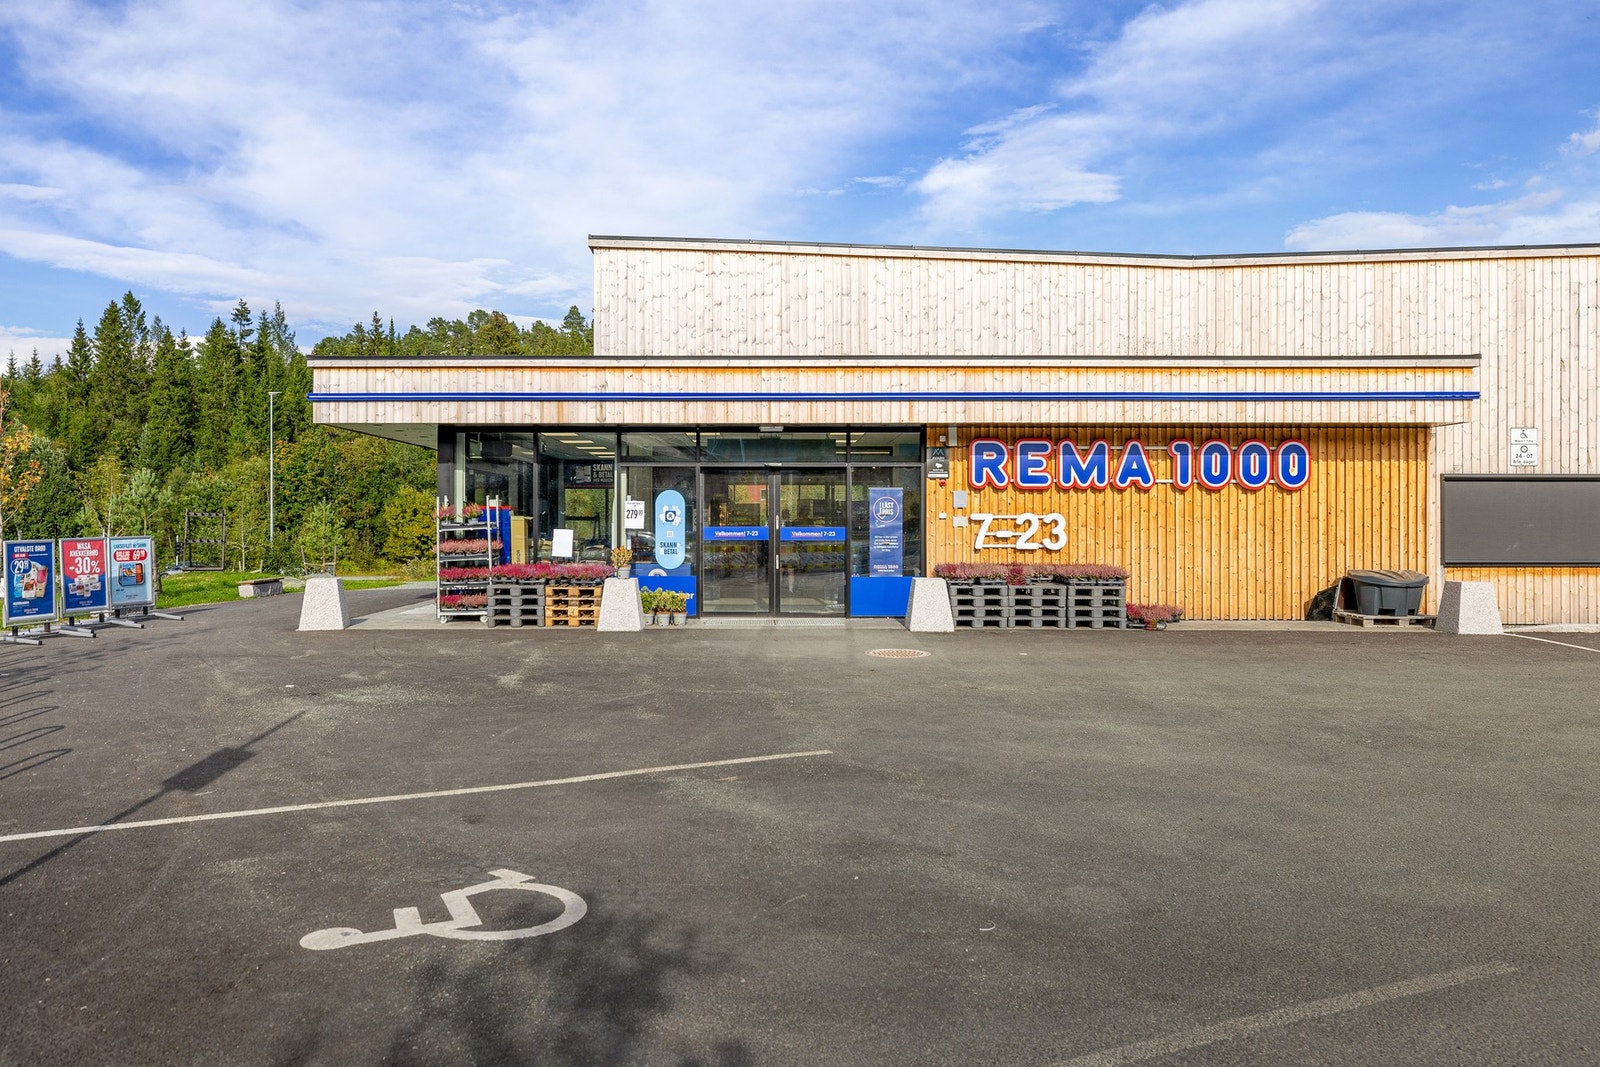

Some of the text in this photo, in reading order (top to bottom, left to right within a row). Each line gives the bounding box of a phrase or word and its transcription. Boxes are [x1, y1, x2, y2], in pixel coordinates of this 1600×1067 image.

[969, 438, 1312, 491] REMA 1000
[714, 530, 746, 538] Velkommen!
[791, 530, 823, 538] Velkommen!
[970, 513, 1067, 551] 7-23
[69, 557, 100, 574] -30%
